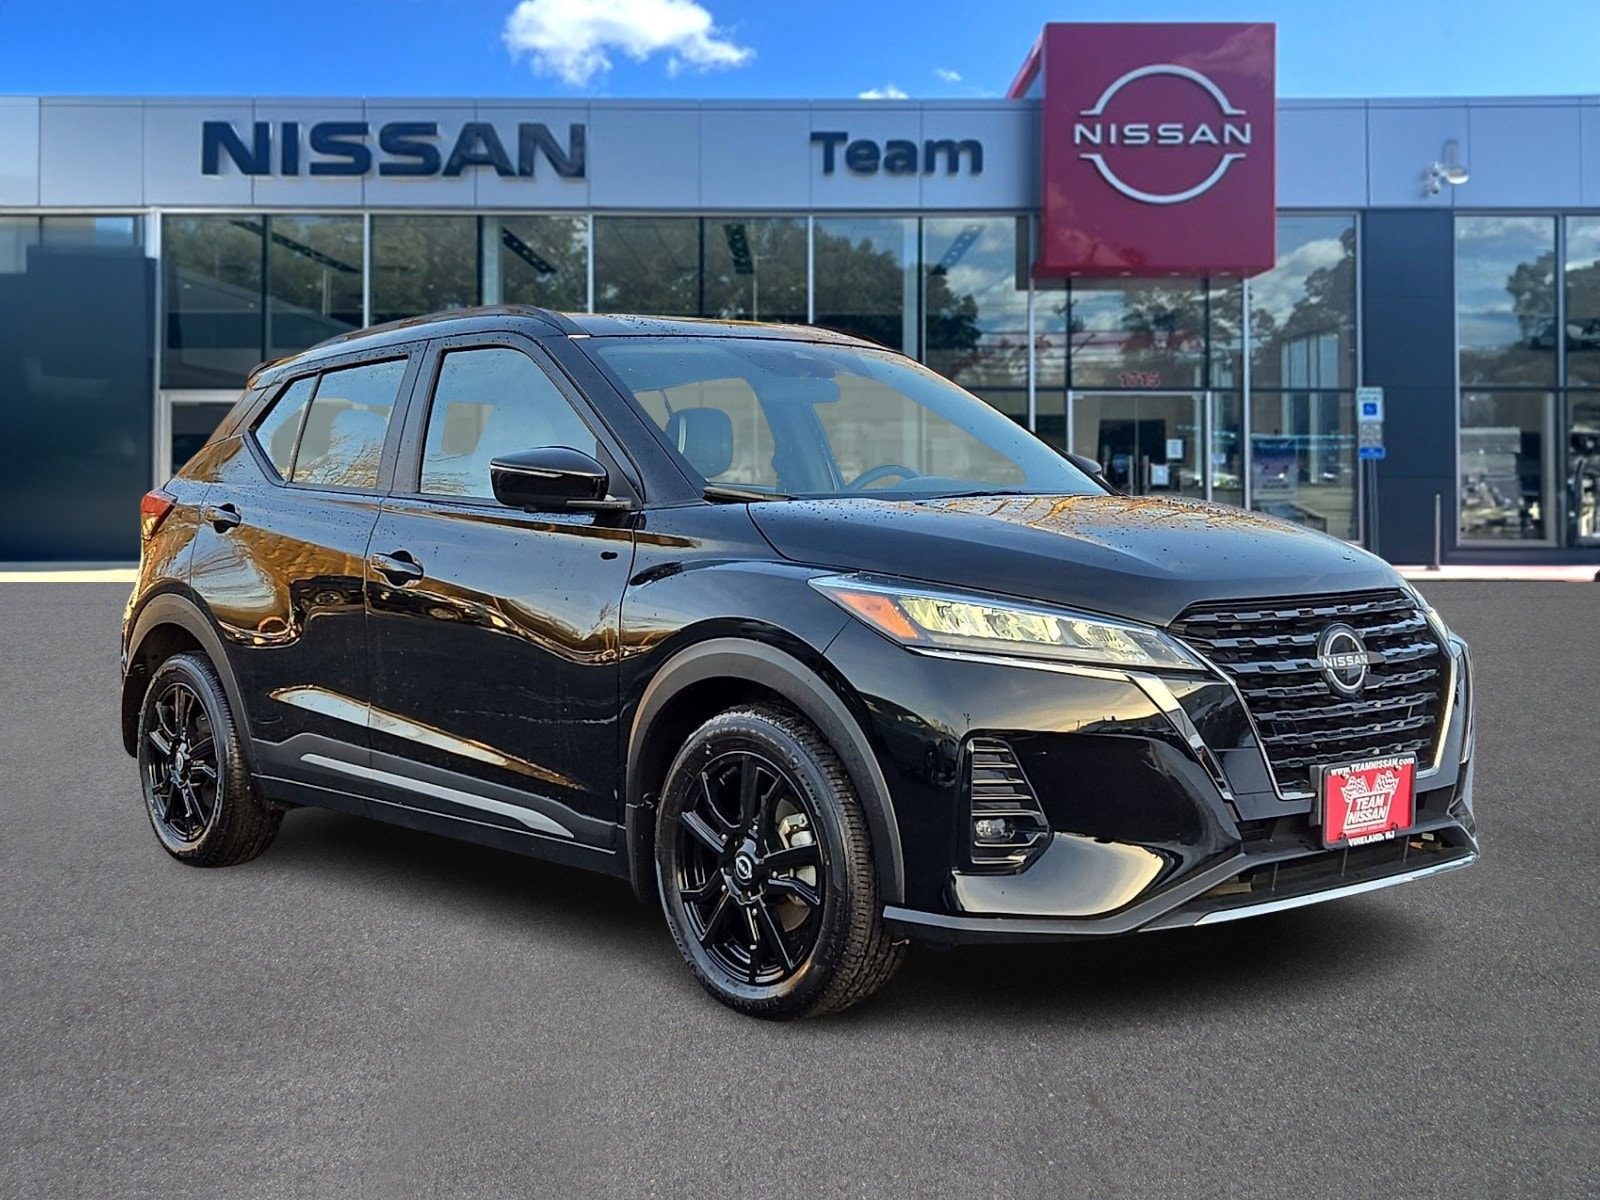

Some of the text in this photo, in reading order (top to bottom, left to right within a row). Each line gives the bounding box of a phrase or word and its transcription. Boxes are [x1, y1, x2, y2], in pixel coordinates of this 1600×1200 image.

[1074, 122, 1252, 145] NISSAN
[202, 121, 586, 179] NISSAN
[810, 131, 983, 176] Team
[1120, 372, 1160, 388] 1715
[1322, 654, 1369, 668] NISSAN
[1356, 794, 1386, 810] TEAM
[1348, 806, 1387, 824] NISSAN
